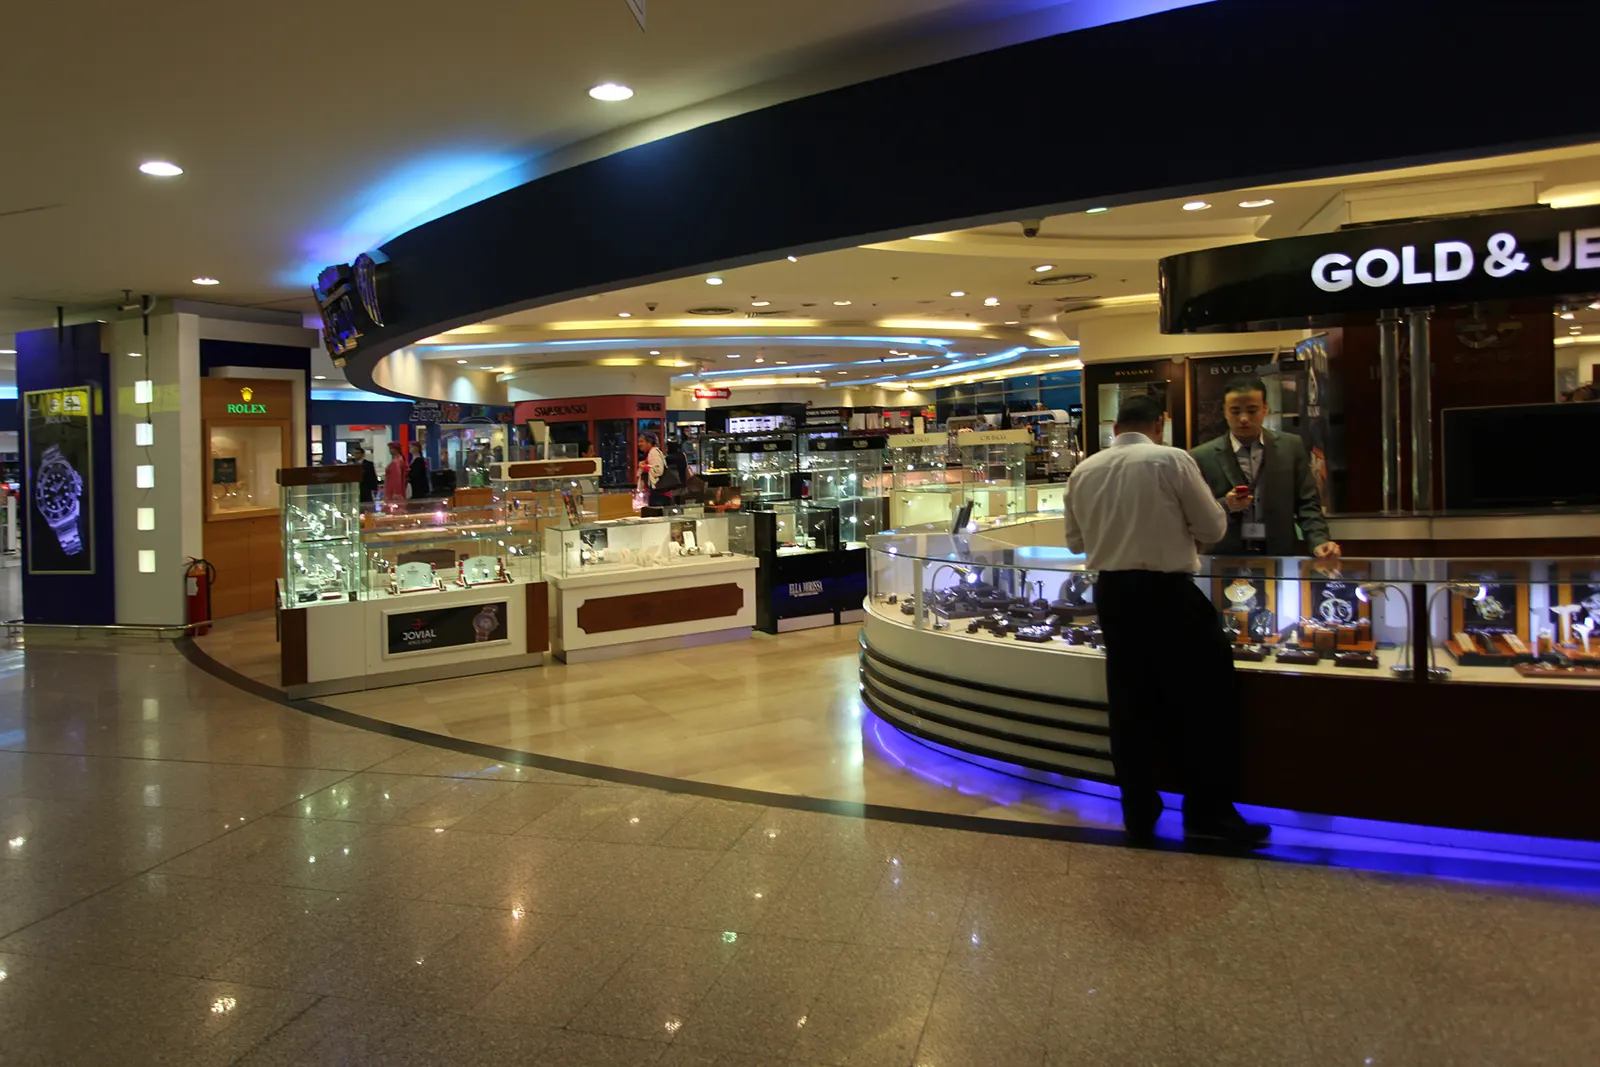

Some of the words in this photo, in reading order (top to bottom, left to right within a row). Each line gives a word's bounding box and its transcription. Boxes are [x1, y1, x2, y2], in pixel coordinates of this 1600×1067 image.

[1311, 241, 1474, 292] GOLD
[1483, 232, 1530, 278] &
[1541, 227, 1600, 271] JE
[1210, 364, 1262, 376] BVLG
[227, 403, 267, 414] ROLEX
[534, 404, 588, 417] SWAROVSKI
[402, 629, 437, 641] JOVIAL
